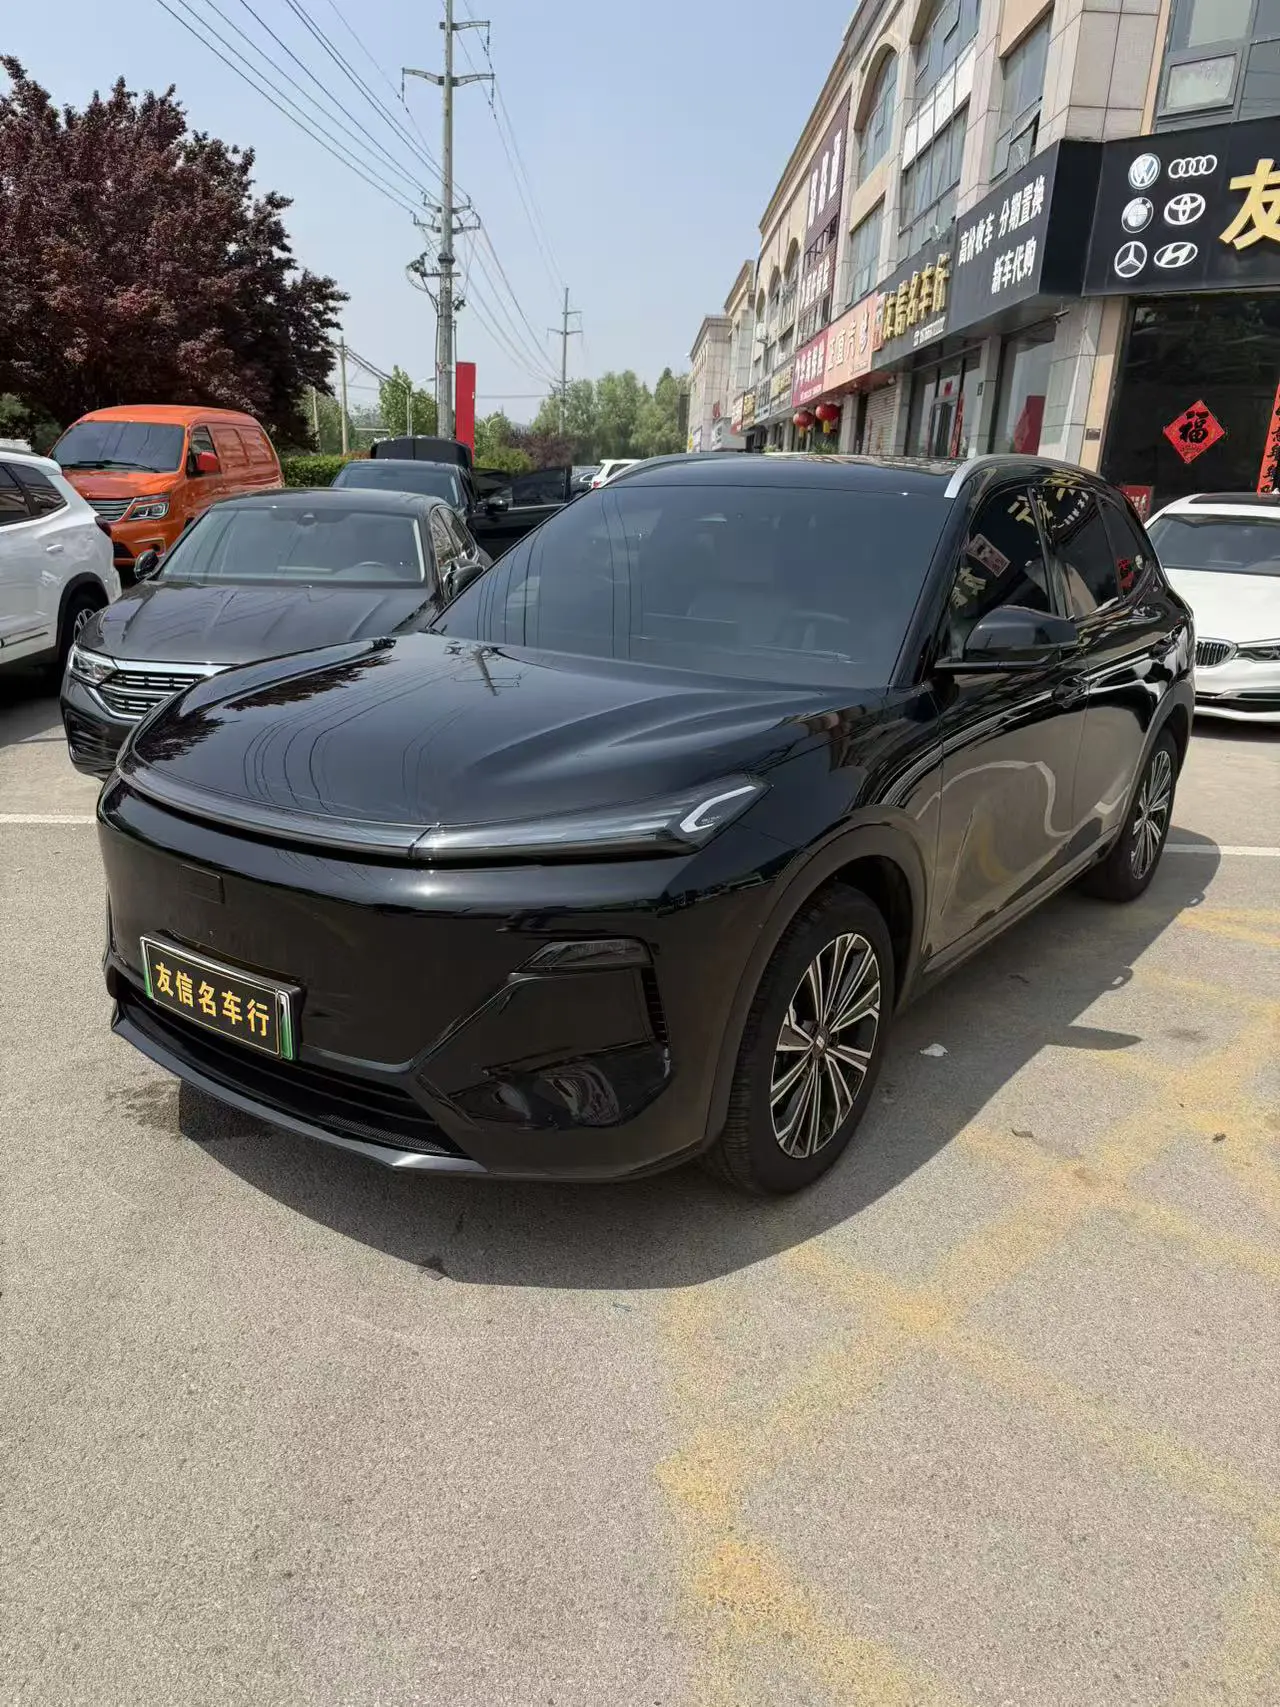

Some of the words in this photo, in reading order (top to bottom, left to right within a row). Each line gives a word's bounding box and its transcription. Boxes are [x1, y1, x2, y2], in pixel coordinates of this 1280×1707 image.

[958, 213, 995, 266] 高价收车
[998, 174, 1045, 238] 分期置换
[1219, 158, 1280, 250] 友
[991, 236, 1037, 295] 新车代购
[1178, 410, 1210, 444] 福
[155, 962, 270, 1036] 友信名车行
